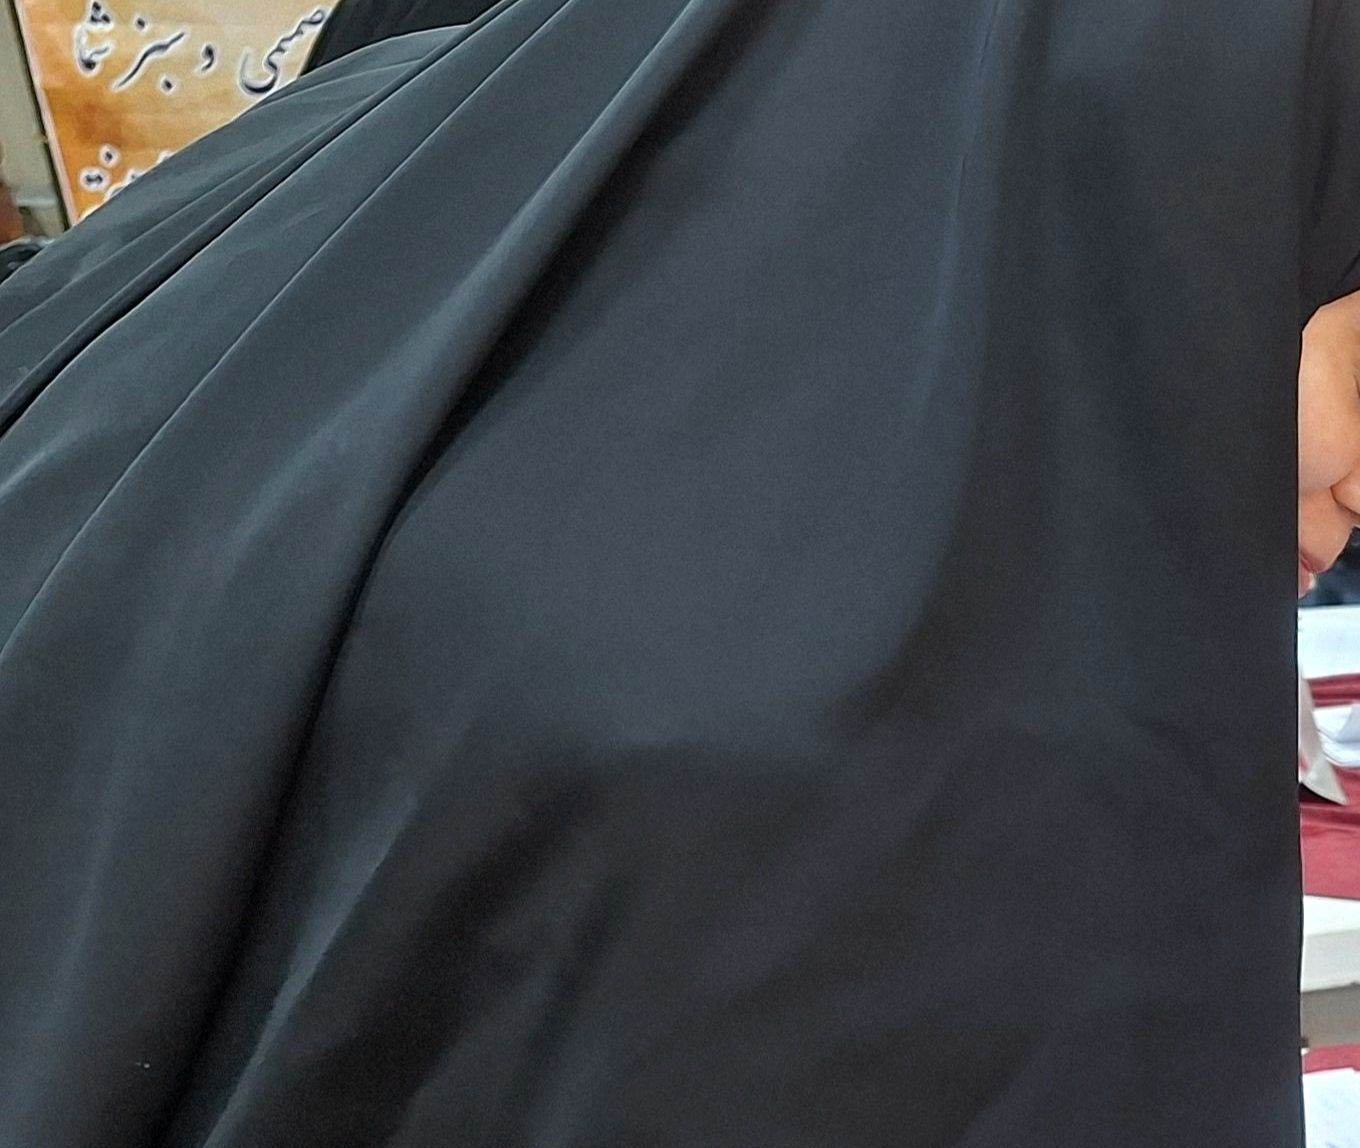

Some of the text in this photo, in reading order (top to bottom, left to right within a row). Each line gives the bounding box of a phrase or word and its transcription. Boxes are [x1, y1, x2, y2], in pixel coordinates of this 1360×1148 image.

[77, 0, 112, 73] شما
[116, 17, 185, 90] سبز
[200, 44, 214, 72] و
